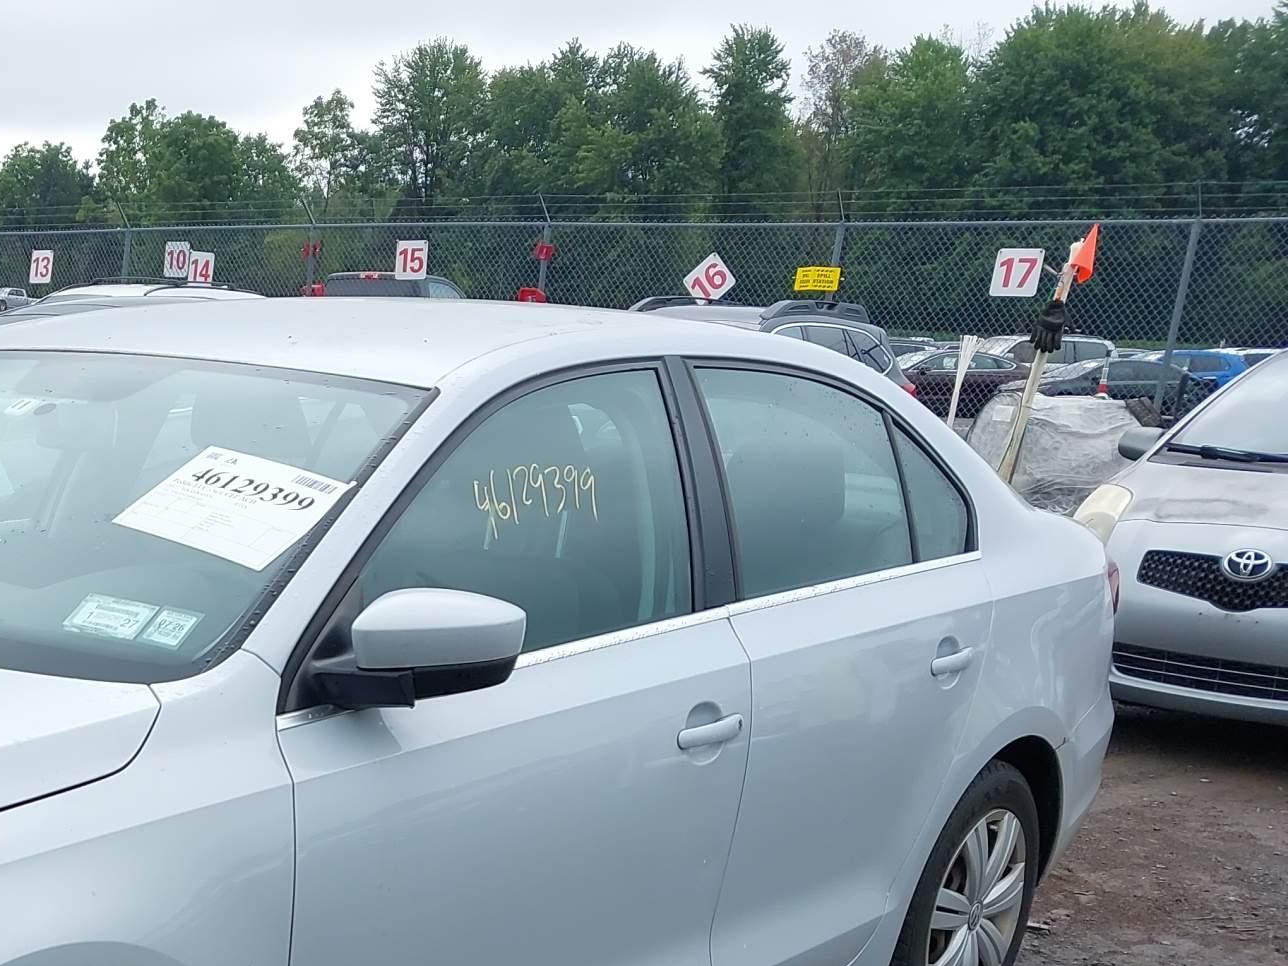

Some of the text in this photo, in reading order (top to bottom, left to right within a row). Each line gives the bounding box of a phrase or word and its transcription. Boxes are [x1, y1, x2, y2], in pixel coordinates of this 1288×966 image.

[33, 256, 51, 278] 13
[167, 249, 187, 271] 10
[191, 258, 211, 282] 14
[398, 247, 424, 274] 15
[999, 257, 1039, 289] 17
[691, 262, 728, 299] 16
[191, 467, 316, 511] 46129399
[473, 463, 599, 540] 46129399
